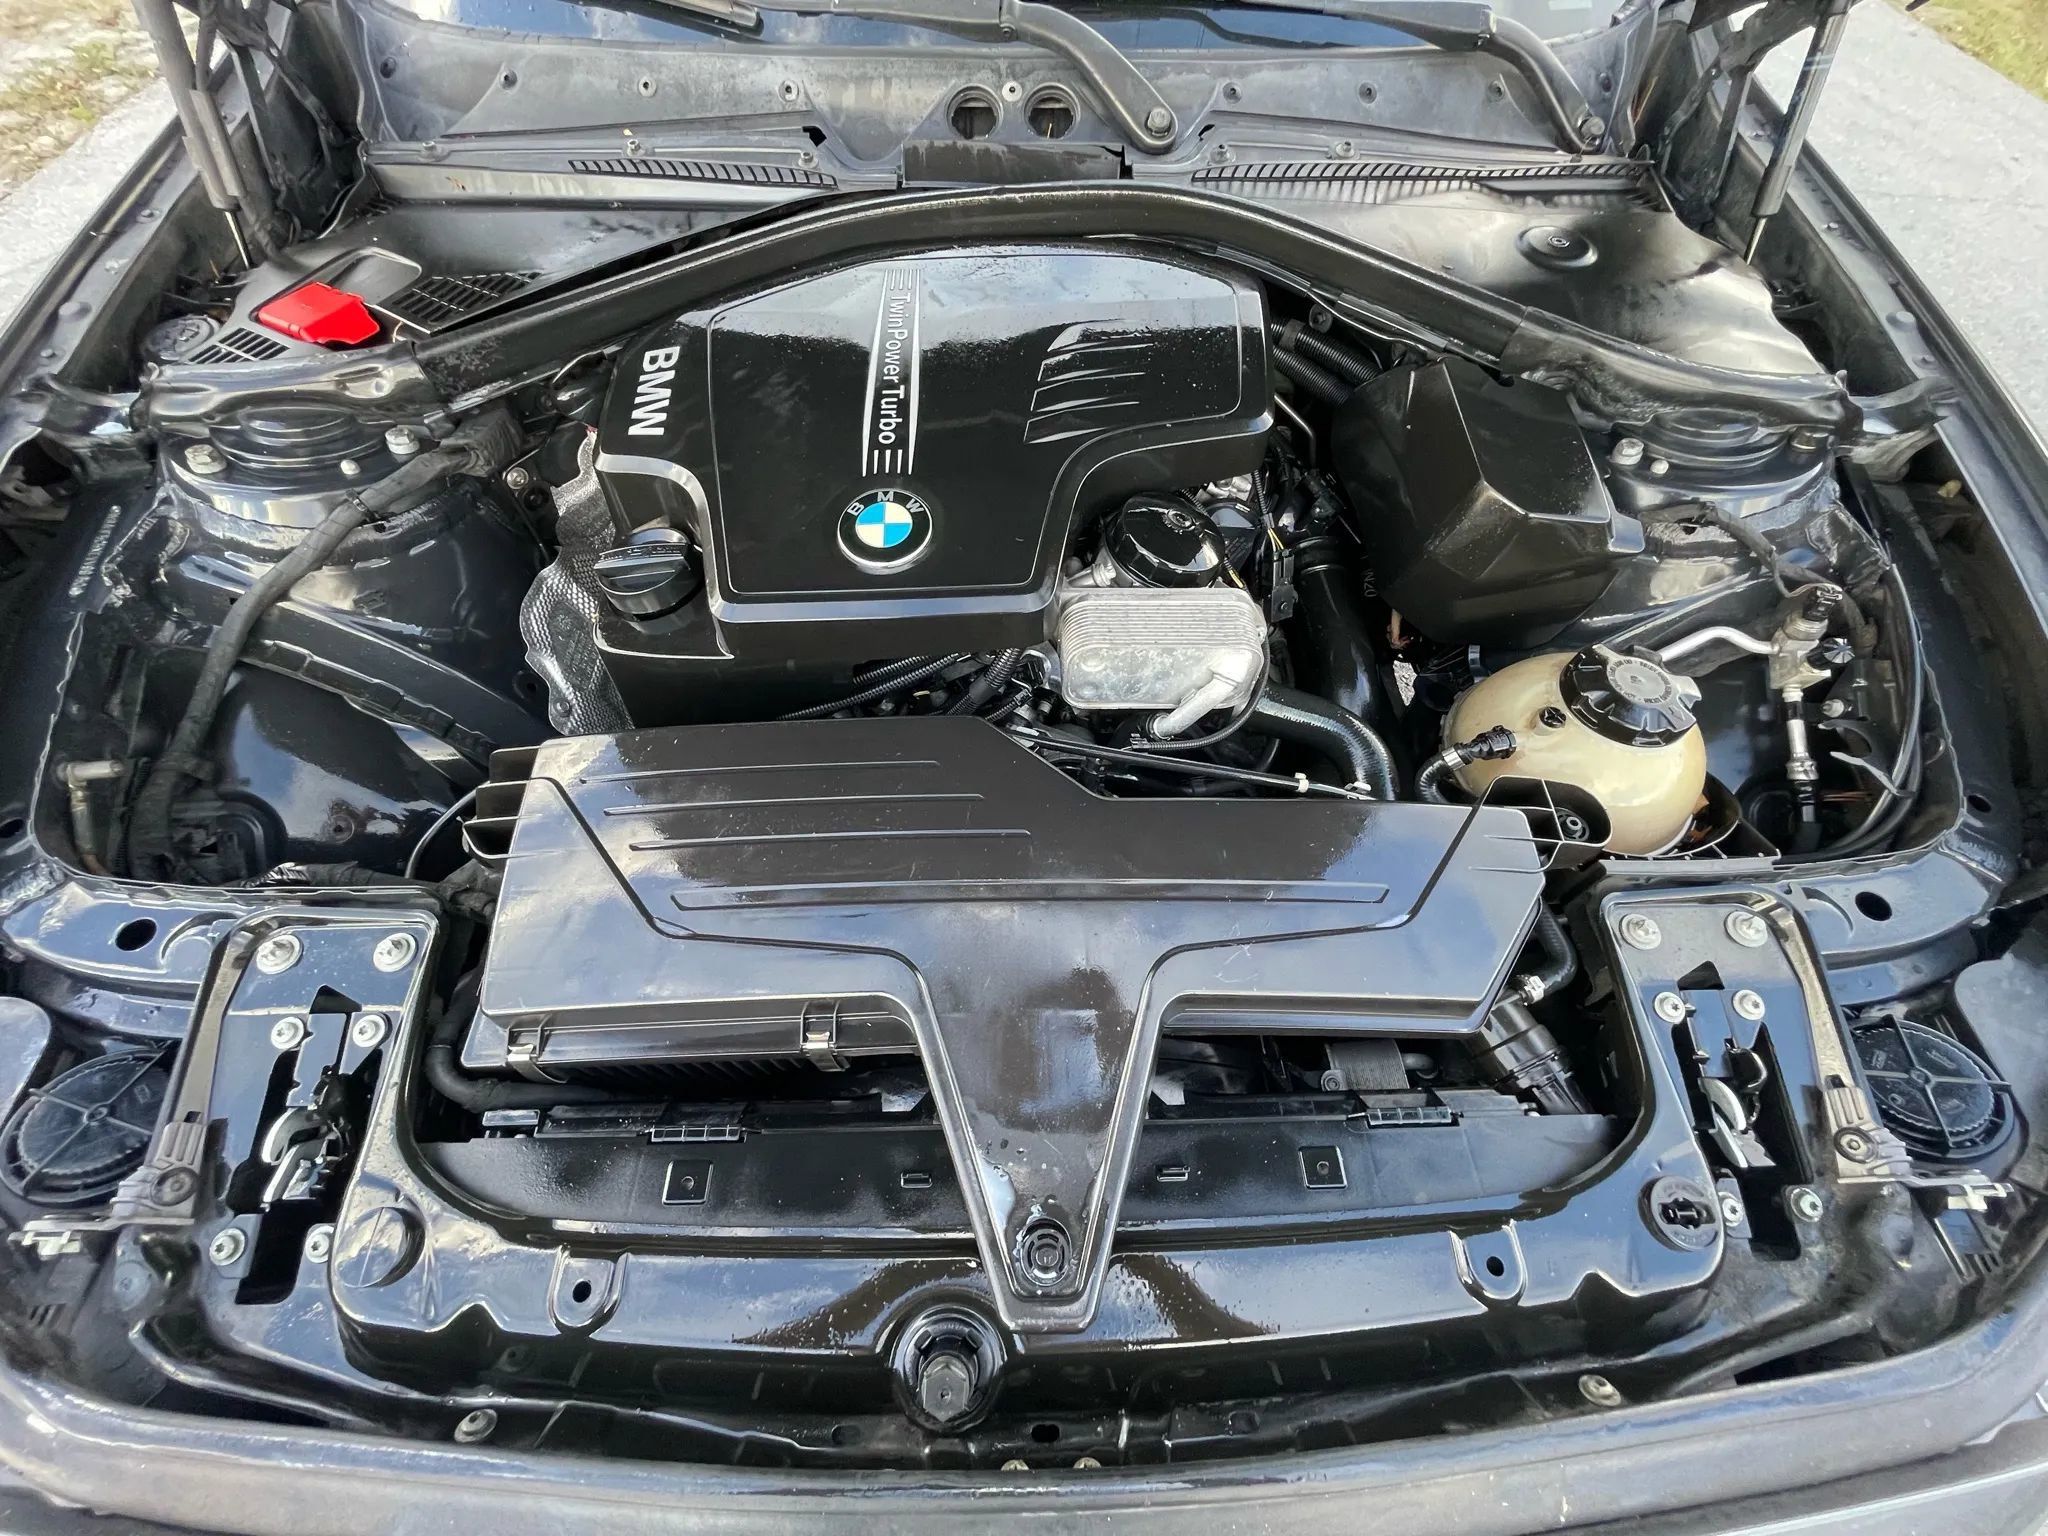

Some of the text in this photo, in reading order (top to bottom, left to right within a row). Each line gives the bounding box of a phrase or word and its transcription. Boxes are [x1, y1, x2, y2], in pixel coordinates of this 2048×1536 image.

[627, 346, 681, 436] BMW
[878, 293, 912, 445] TwinPower Turbo
[846, 490, 925, 517] BMW
